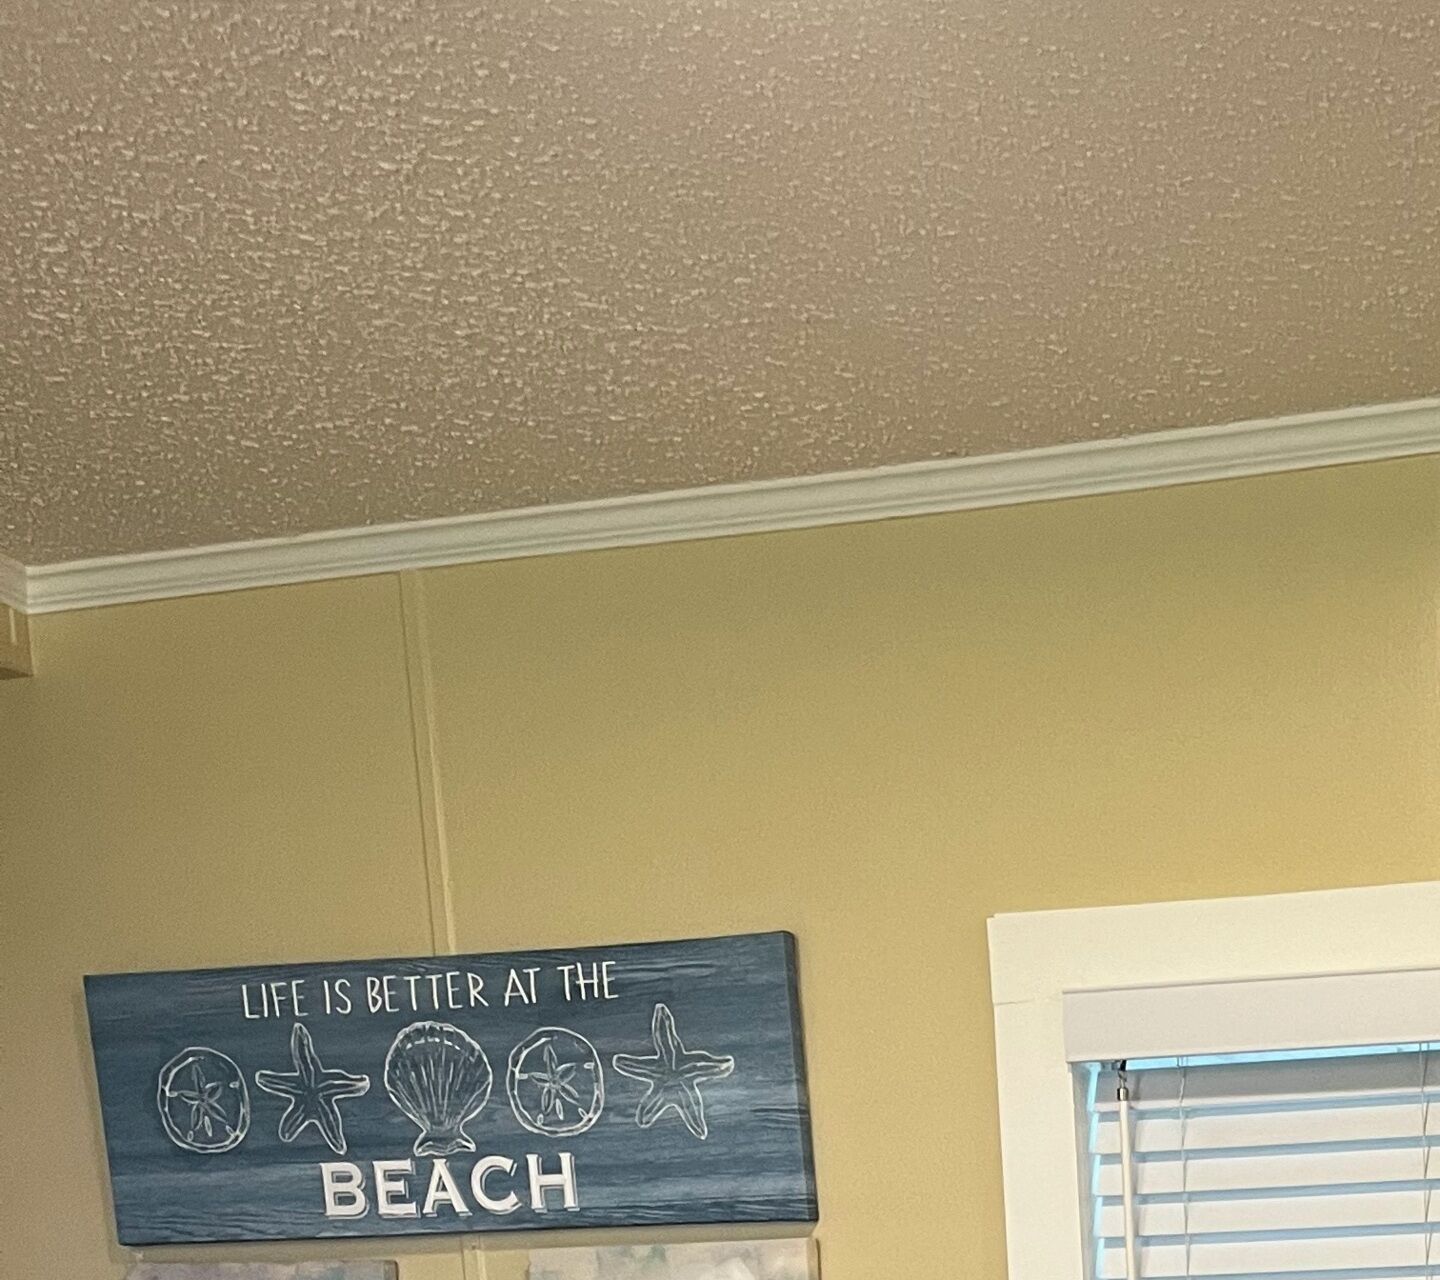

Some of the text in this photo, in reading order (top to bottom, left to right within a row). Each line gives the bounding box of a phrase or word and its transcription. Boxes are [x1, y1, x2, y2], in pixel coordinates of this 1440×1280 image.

[241, 961, 619, 1020] LIFE IS BETTER AT THE
[319, 1152, 580, 1219] BEACH
